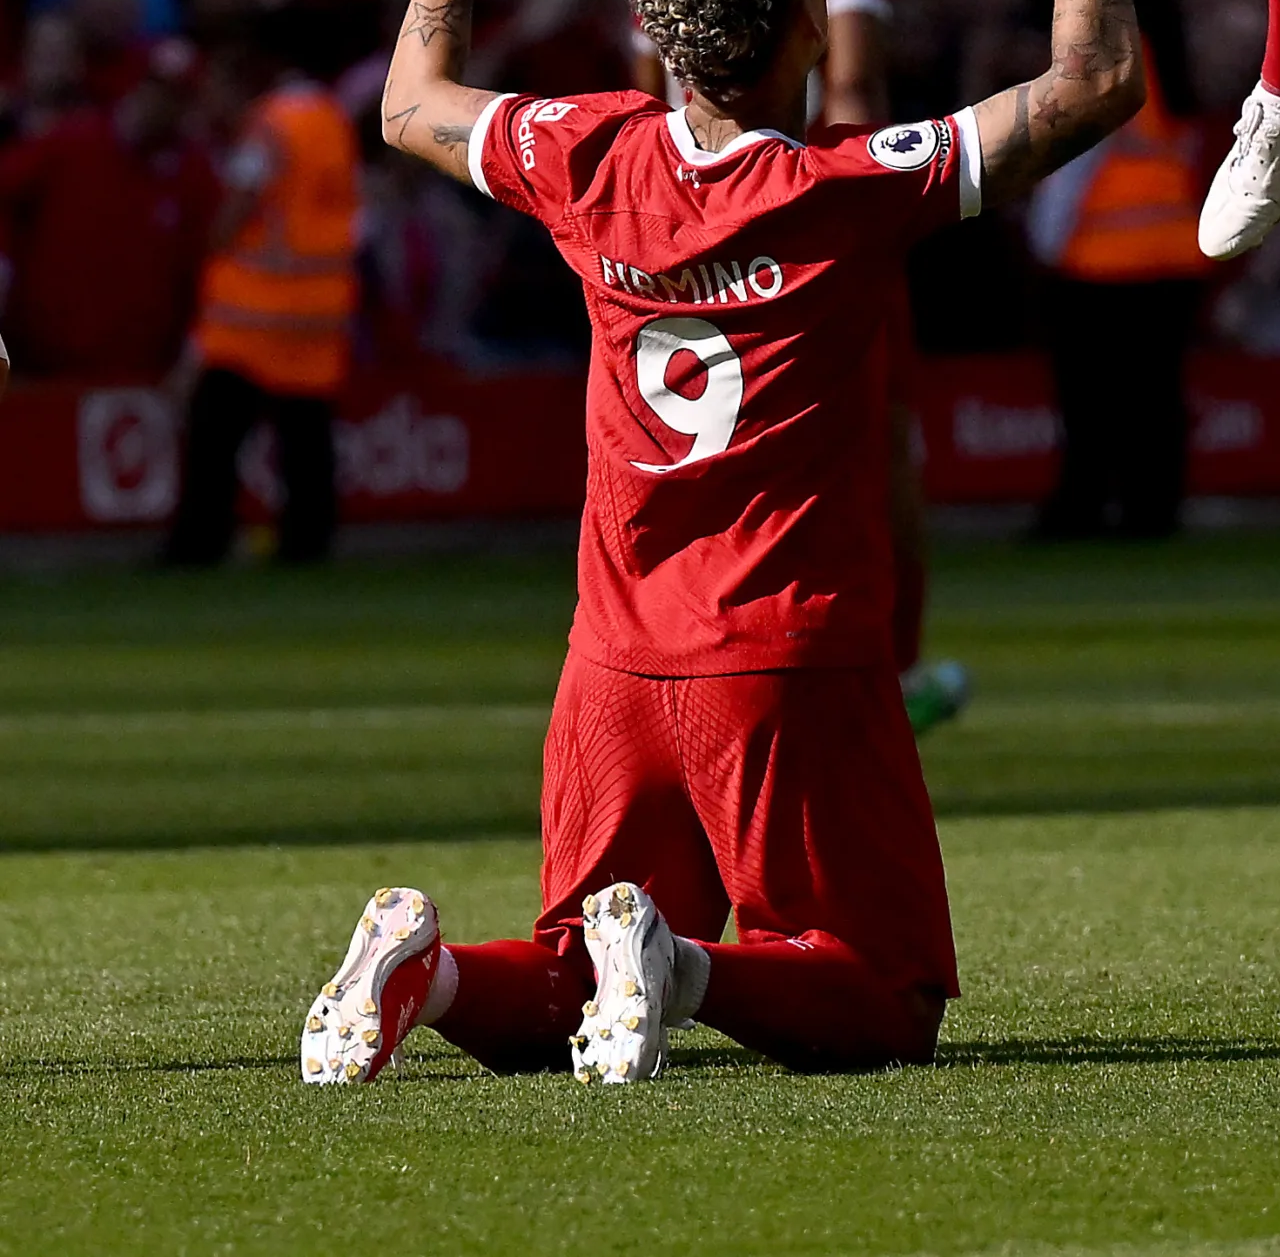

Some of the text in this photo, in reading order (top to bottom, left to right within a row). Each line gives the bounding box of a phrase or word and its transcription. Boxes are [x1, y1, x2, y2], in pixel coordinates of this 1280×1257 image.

[518, 98, 553, 171] pedia
[600, 254, 783, 305] FIRMINO
[630, 317, 744, 474] 9
